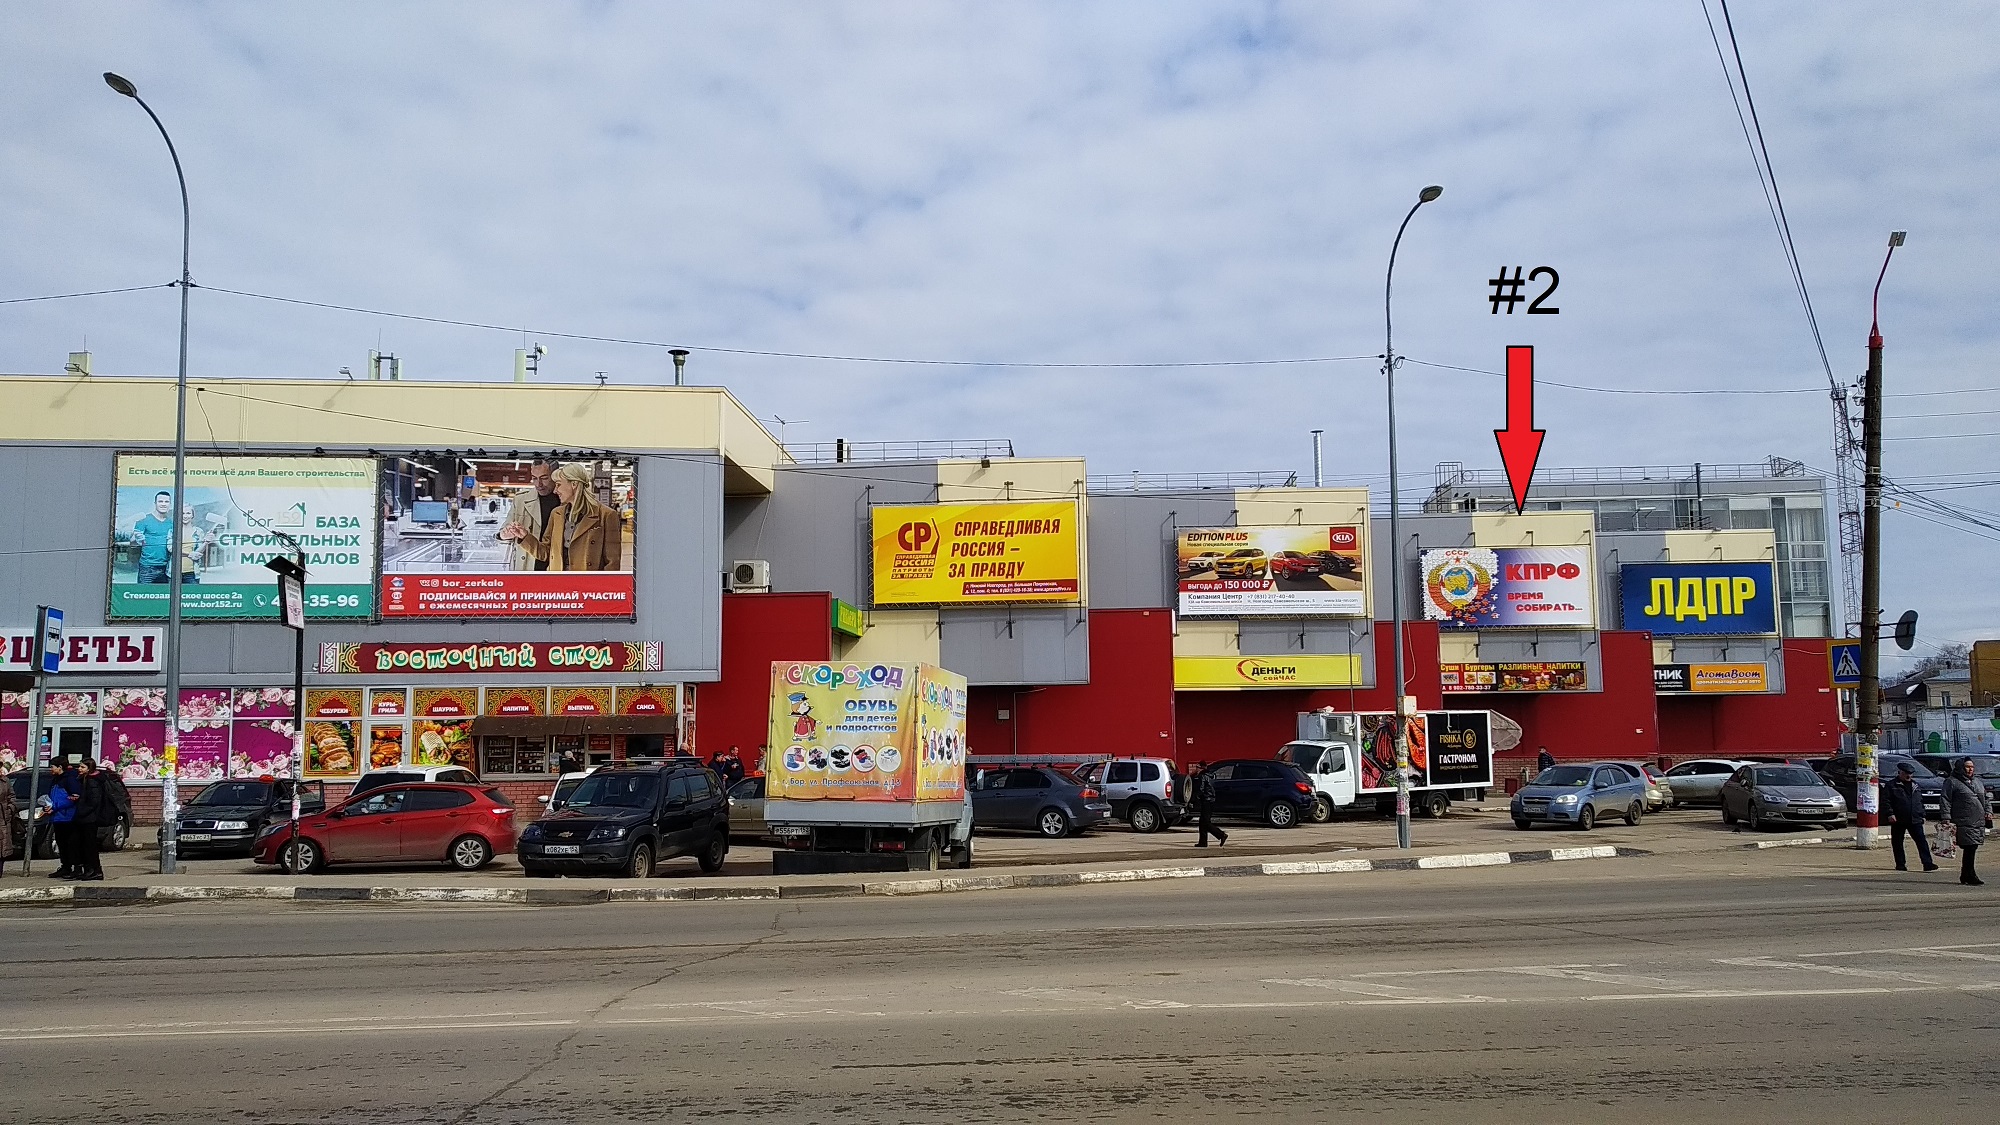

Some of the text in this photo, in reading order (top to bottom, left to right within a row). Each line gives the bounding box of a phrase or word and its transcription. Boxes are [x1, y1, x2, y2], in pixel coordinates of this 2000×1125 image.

[316, 516, 360, 528] БАЗА
[954, 518, 1060, 537] СПРАВЕДЛИВАЯ
[219, 534, 360, 546] СТРОИЕЛЬНЫХ
[898, 521, 931, 551] СР
[1188, 532, 1248, 541] EDITION PLUS
[951, 542, 1006, 558] РОССИЯ
[948, 562, 1026, 578] ЗА ПРАВДУ
[1506, 563, 1580, 580] КПРФ
[442, 579, 504, 588] bor_zerkalo
[124, 592, 201, 600] Стеклозавское
[231, 592, 242, 600] 2а
[420, 591, 506, 601] ПОДПИСЫВАЙСЯ
[520, 590, 580, 600] ПРИНИМАЙ
[582, 592, 626, 600] УЧАСТИЕ
[1644, 577, 1756, 622] ЛДПР
[1252, 667, 1296, 676] ДЕНЬГИ
[1465, 664, 1495, 672] Бургеры
[1696, 669, 1761, 678] AromaBoom
[787, 664, 904, 690] СКОРОХОД
[844, 700, 898, 712] ОБУВЬ
[867, 714, 896, 722] детей
[1440, 734, 1461, 743] FISHKA
[1439, 754, 1477, 764] ГАСТРОНОМ
